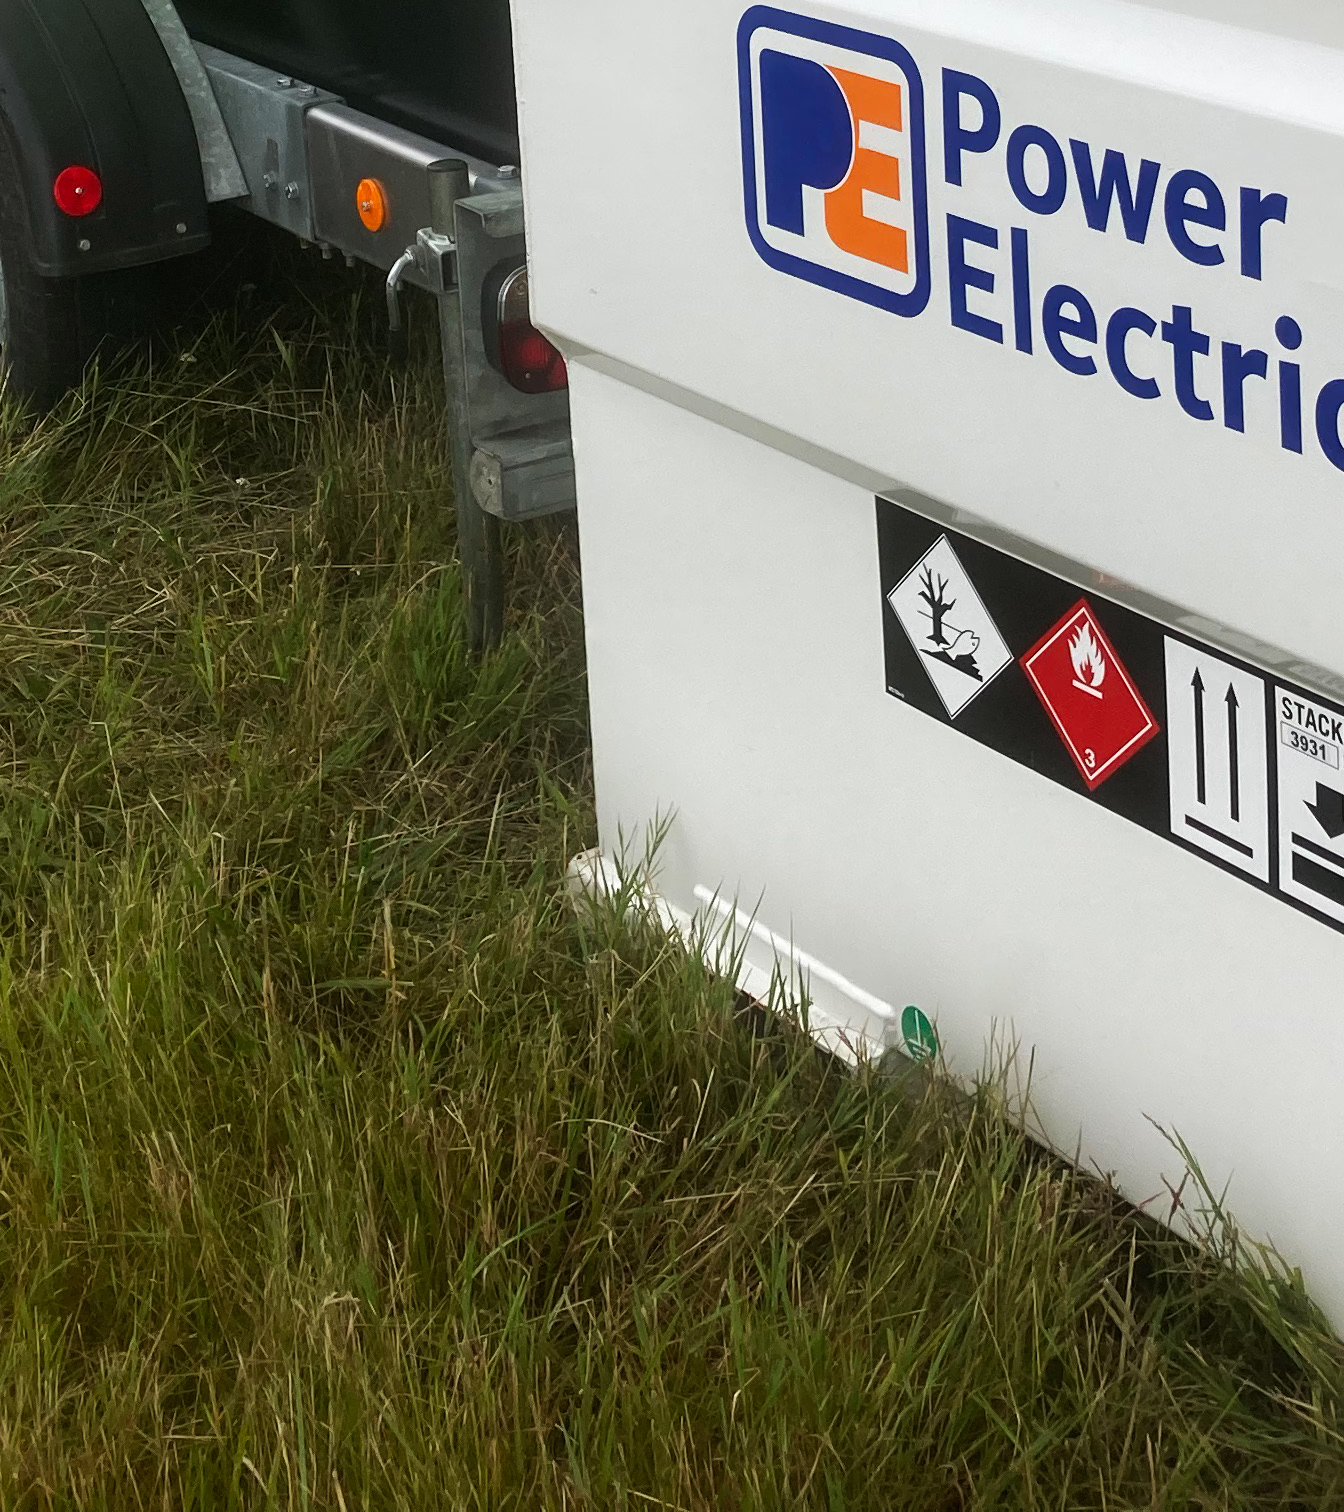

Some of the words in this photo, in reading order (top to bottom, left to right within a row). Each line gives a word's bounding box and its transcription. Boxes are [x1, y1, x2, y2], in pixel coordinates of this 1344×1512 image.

[942, 67, 1287, 281] Power
[1084, 748, 1096, 768] 3
[1290, 731, 1326, 760] 3931
